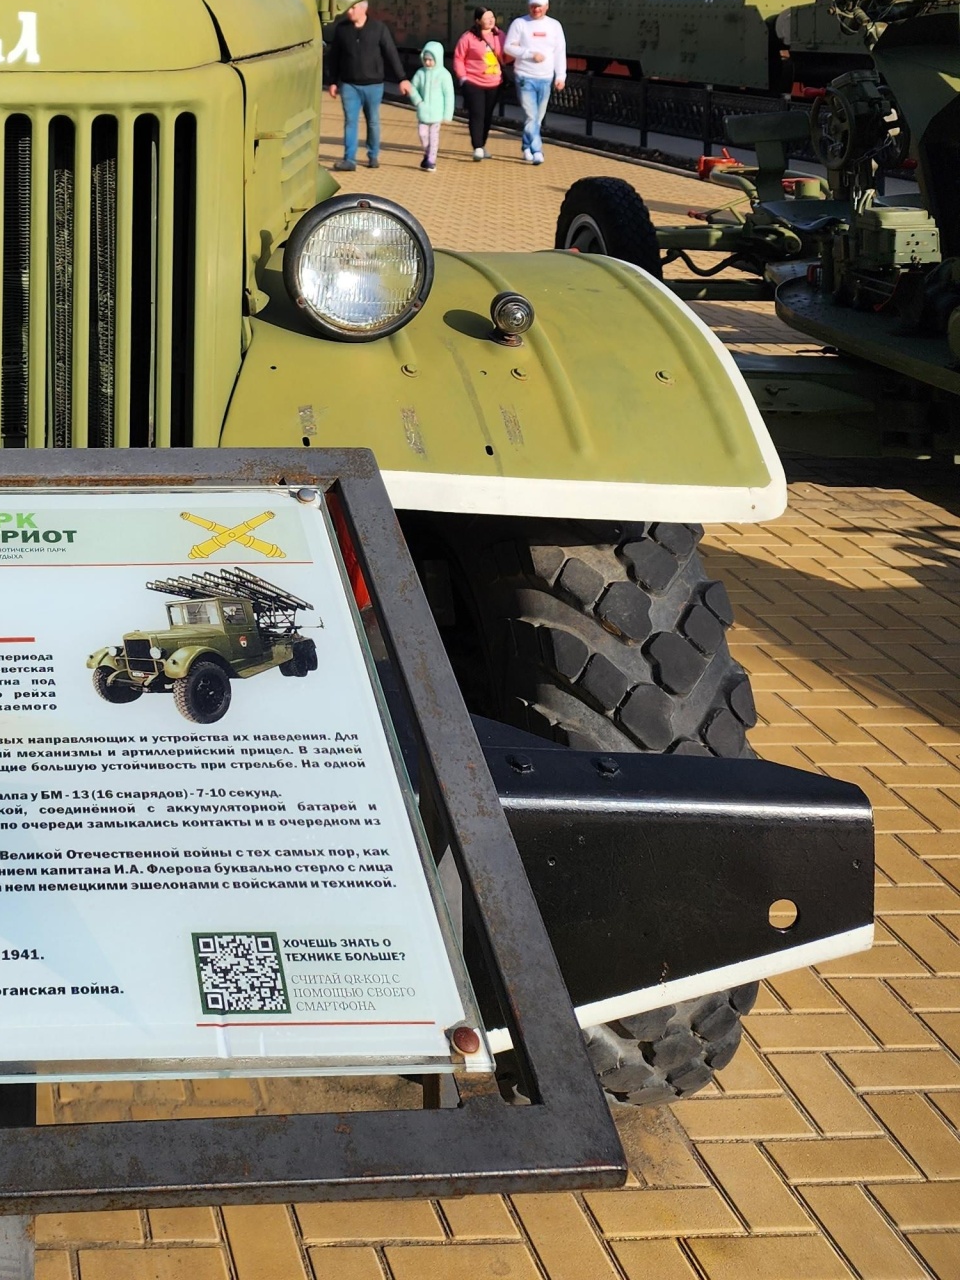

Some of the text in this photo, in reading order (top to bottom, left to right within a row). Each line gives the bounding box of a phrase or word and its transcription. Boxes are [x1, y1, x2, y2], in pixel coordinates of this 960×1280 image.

[31, 678, 57, 687] под
[13, 688, 57, 700] рейха
[16, 749, 102, 758] механизмы
[107, 749, 116, 757] и
[121, 748, 236, 759] артиллерийский
[240, 747, 294, 757] прицел.
[298, 745, 308, 755] В
[312, 744, 363, 756] задней
[38, 805, 136, 816] соединённой
[147, 805, 156, 813] с
[166, 804, 287, 815] аккумуляторной
[297, 801, 357, 813] батарей
[368, 803, 377, 811] и
[40, 866, 111, 876] капитана
[113, 864, 144, 875] И.А.
[146, 864, 212, 876] Флерова
[214, 863, 292, 876] буквально
[294, 864, 345, 875] стерло
[347, 864, 356, 872] с
[358, 864, 394, 874] лица
[4, 883, 36, 892] нем
[38, 882, 128, 892] немецкими
[130, 881, 220, 890] эшелонами
[221, 881, 230, 889] с
[232, 878, 308, 889] войсками
[310, 880, 320, 888] и
[320, 876, 397, 888] техникой.
[282, 938, 392, 948] ХОЧЕШЬ ЗНАТЬ О
[1, 948, 45, 961] 1941.
[285, 952, 406, 962] ТЕХНИКЕ БОЛЬШЕ?
[291, 972, 400, 985] СЧИТАЙ QR-КОД С
[70, 982, 124, 995] война.
[293, 987, 416, 999] ПОМОЩЬЮ СВОЕГО
[296, 1001, 376, 1012] СМАРТФОНА
